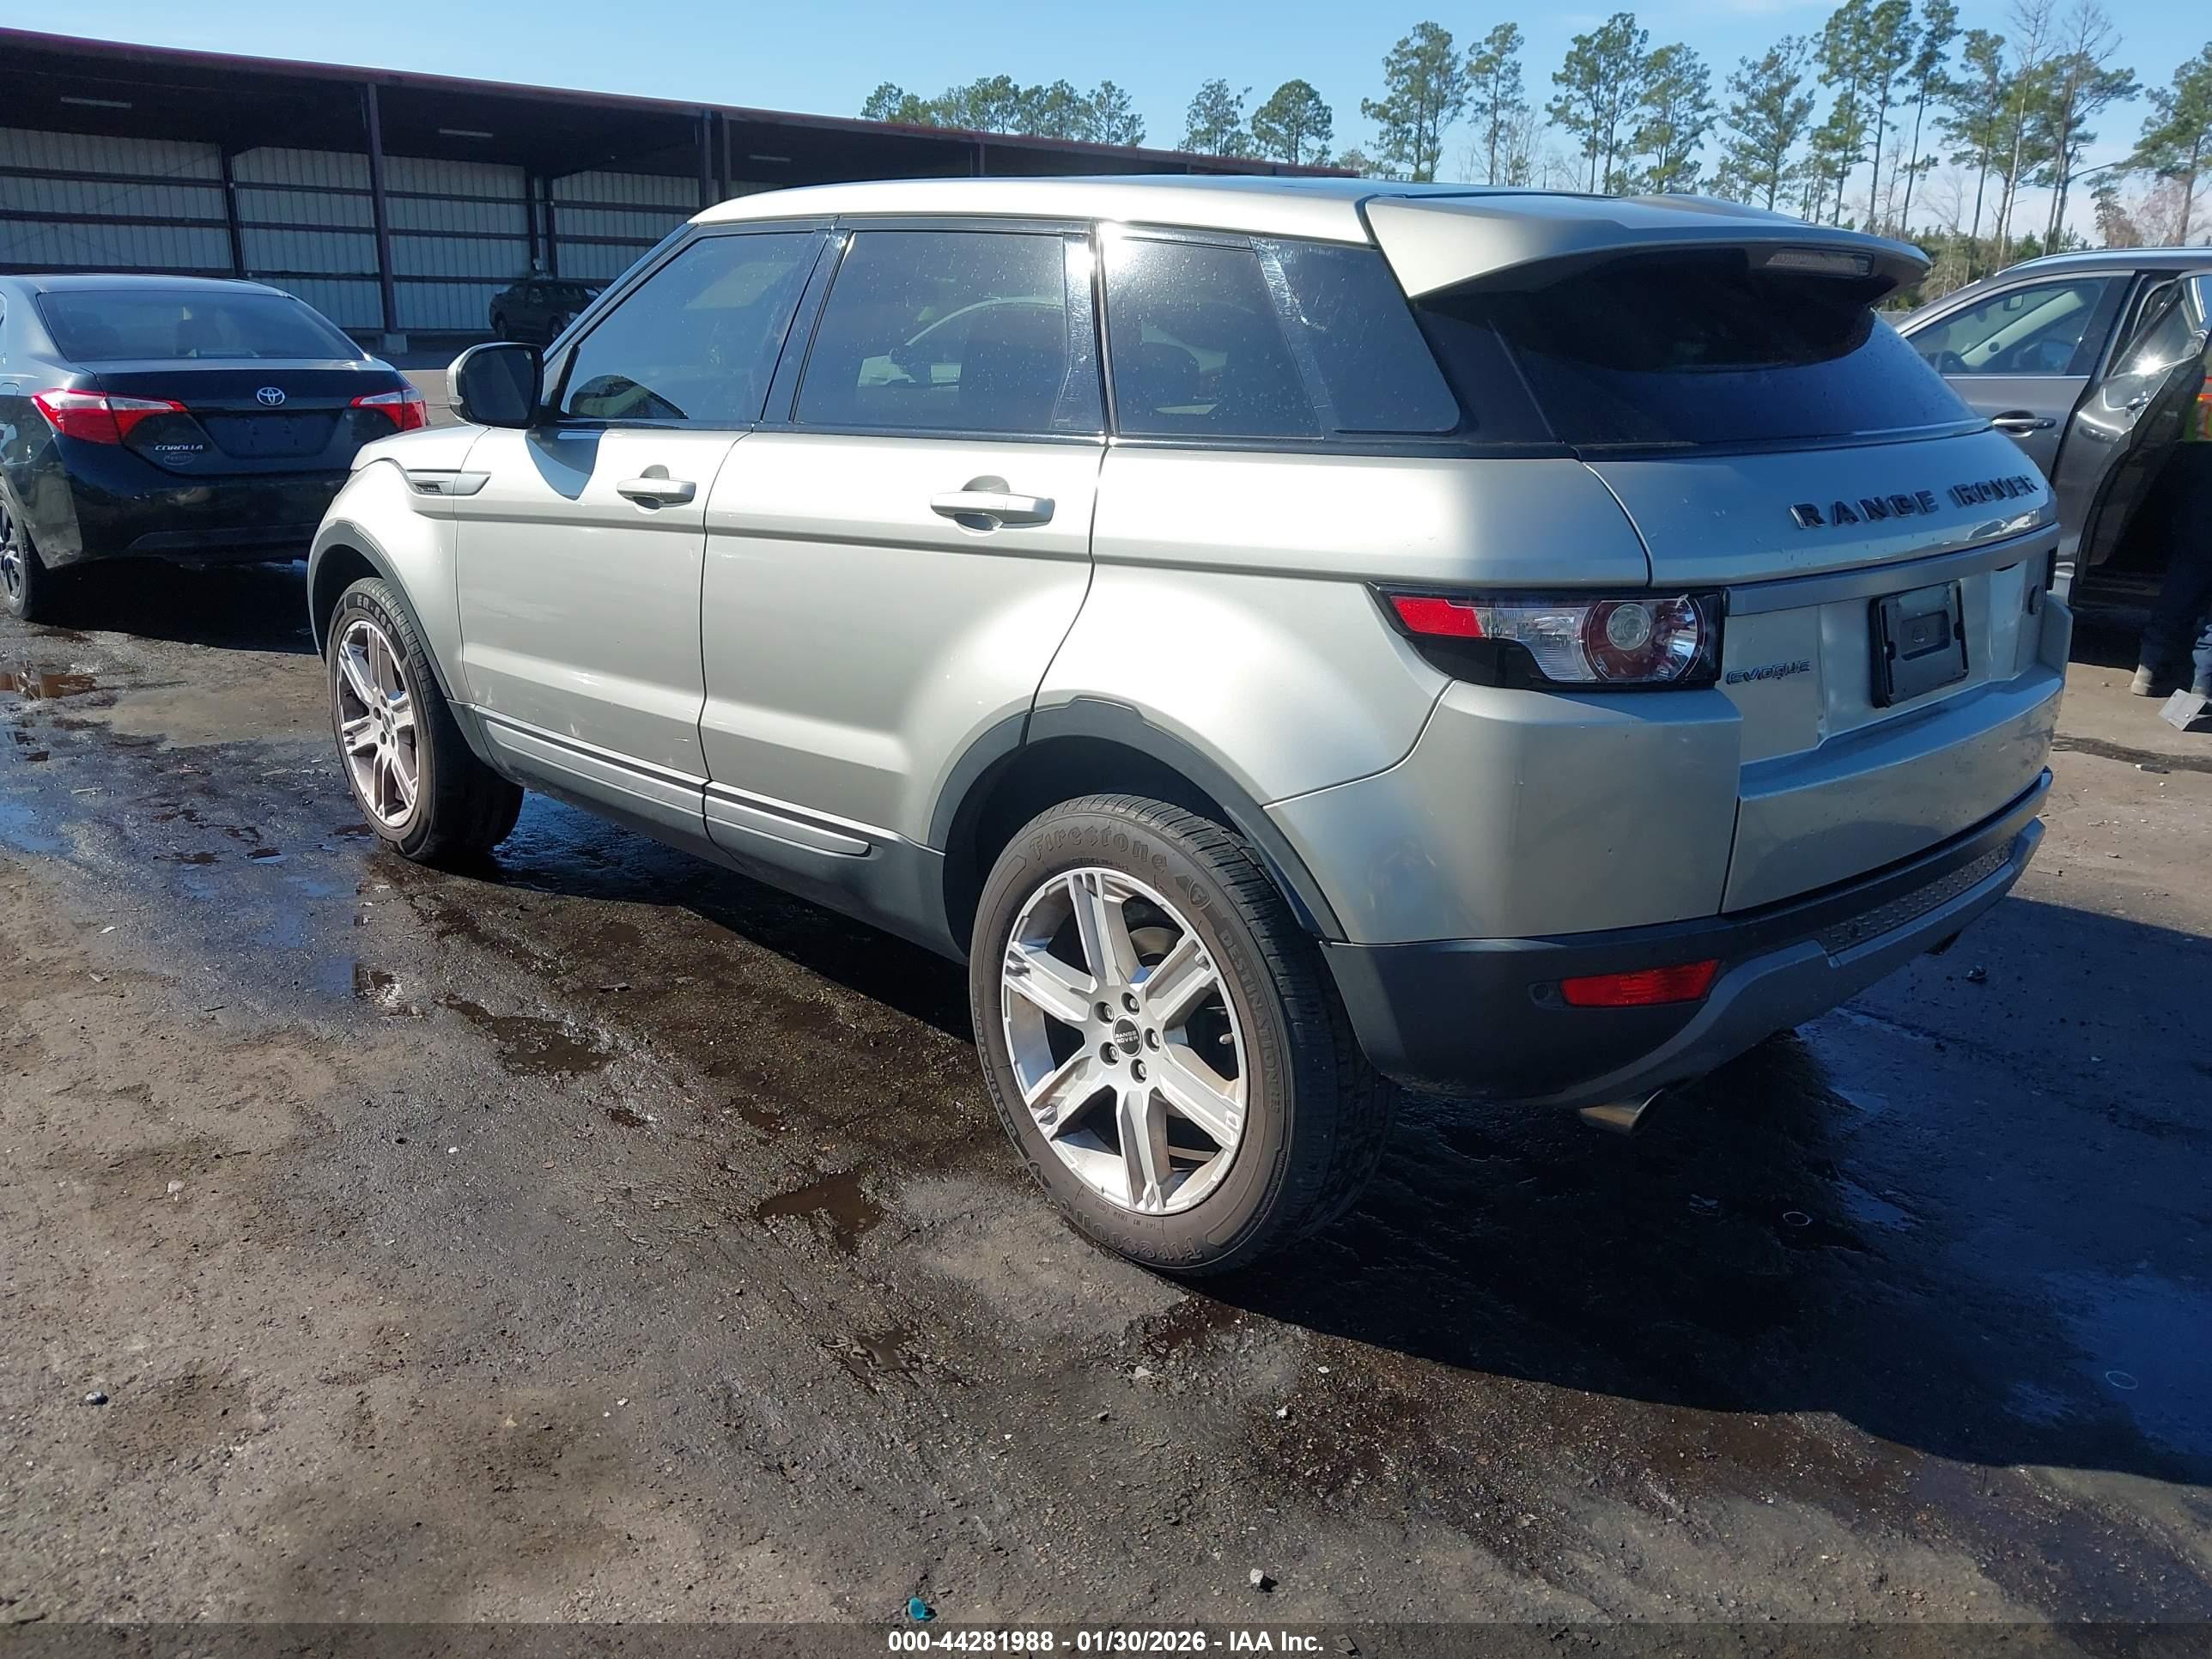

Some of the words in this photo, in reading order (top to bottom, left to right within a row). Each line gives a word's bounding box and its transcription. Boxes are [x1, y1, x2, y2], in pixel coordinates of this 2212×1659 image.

[1788, 489, 1939, 529] RANGE
[1947, 474, 2039, 508] ROVER
[1726, 659, 1810, 684] EVOQUE
[1030, 820, 1168, 874] Firestone
[1219, 928, 1279, 1088] DESTINATION
